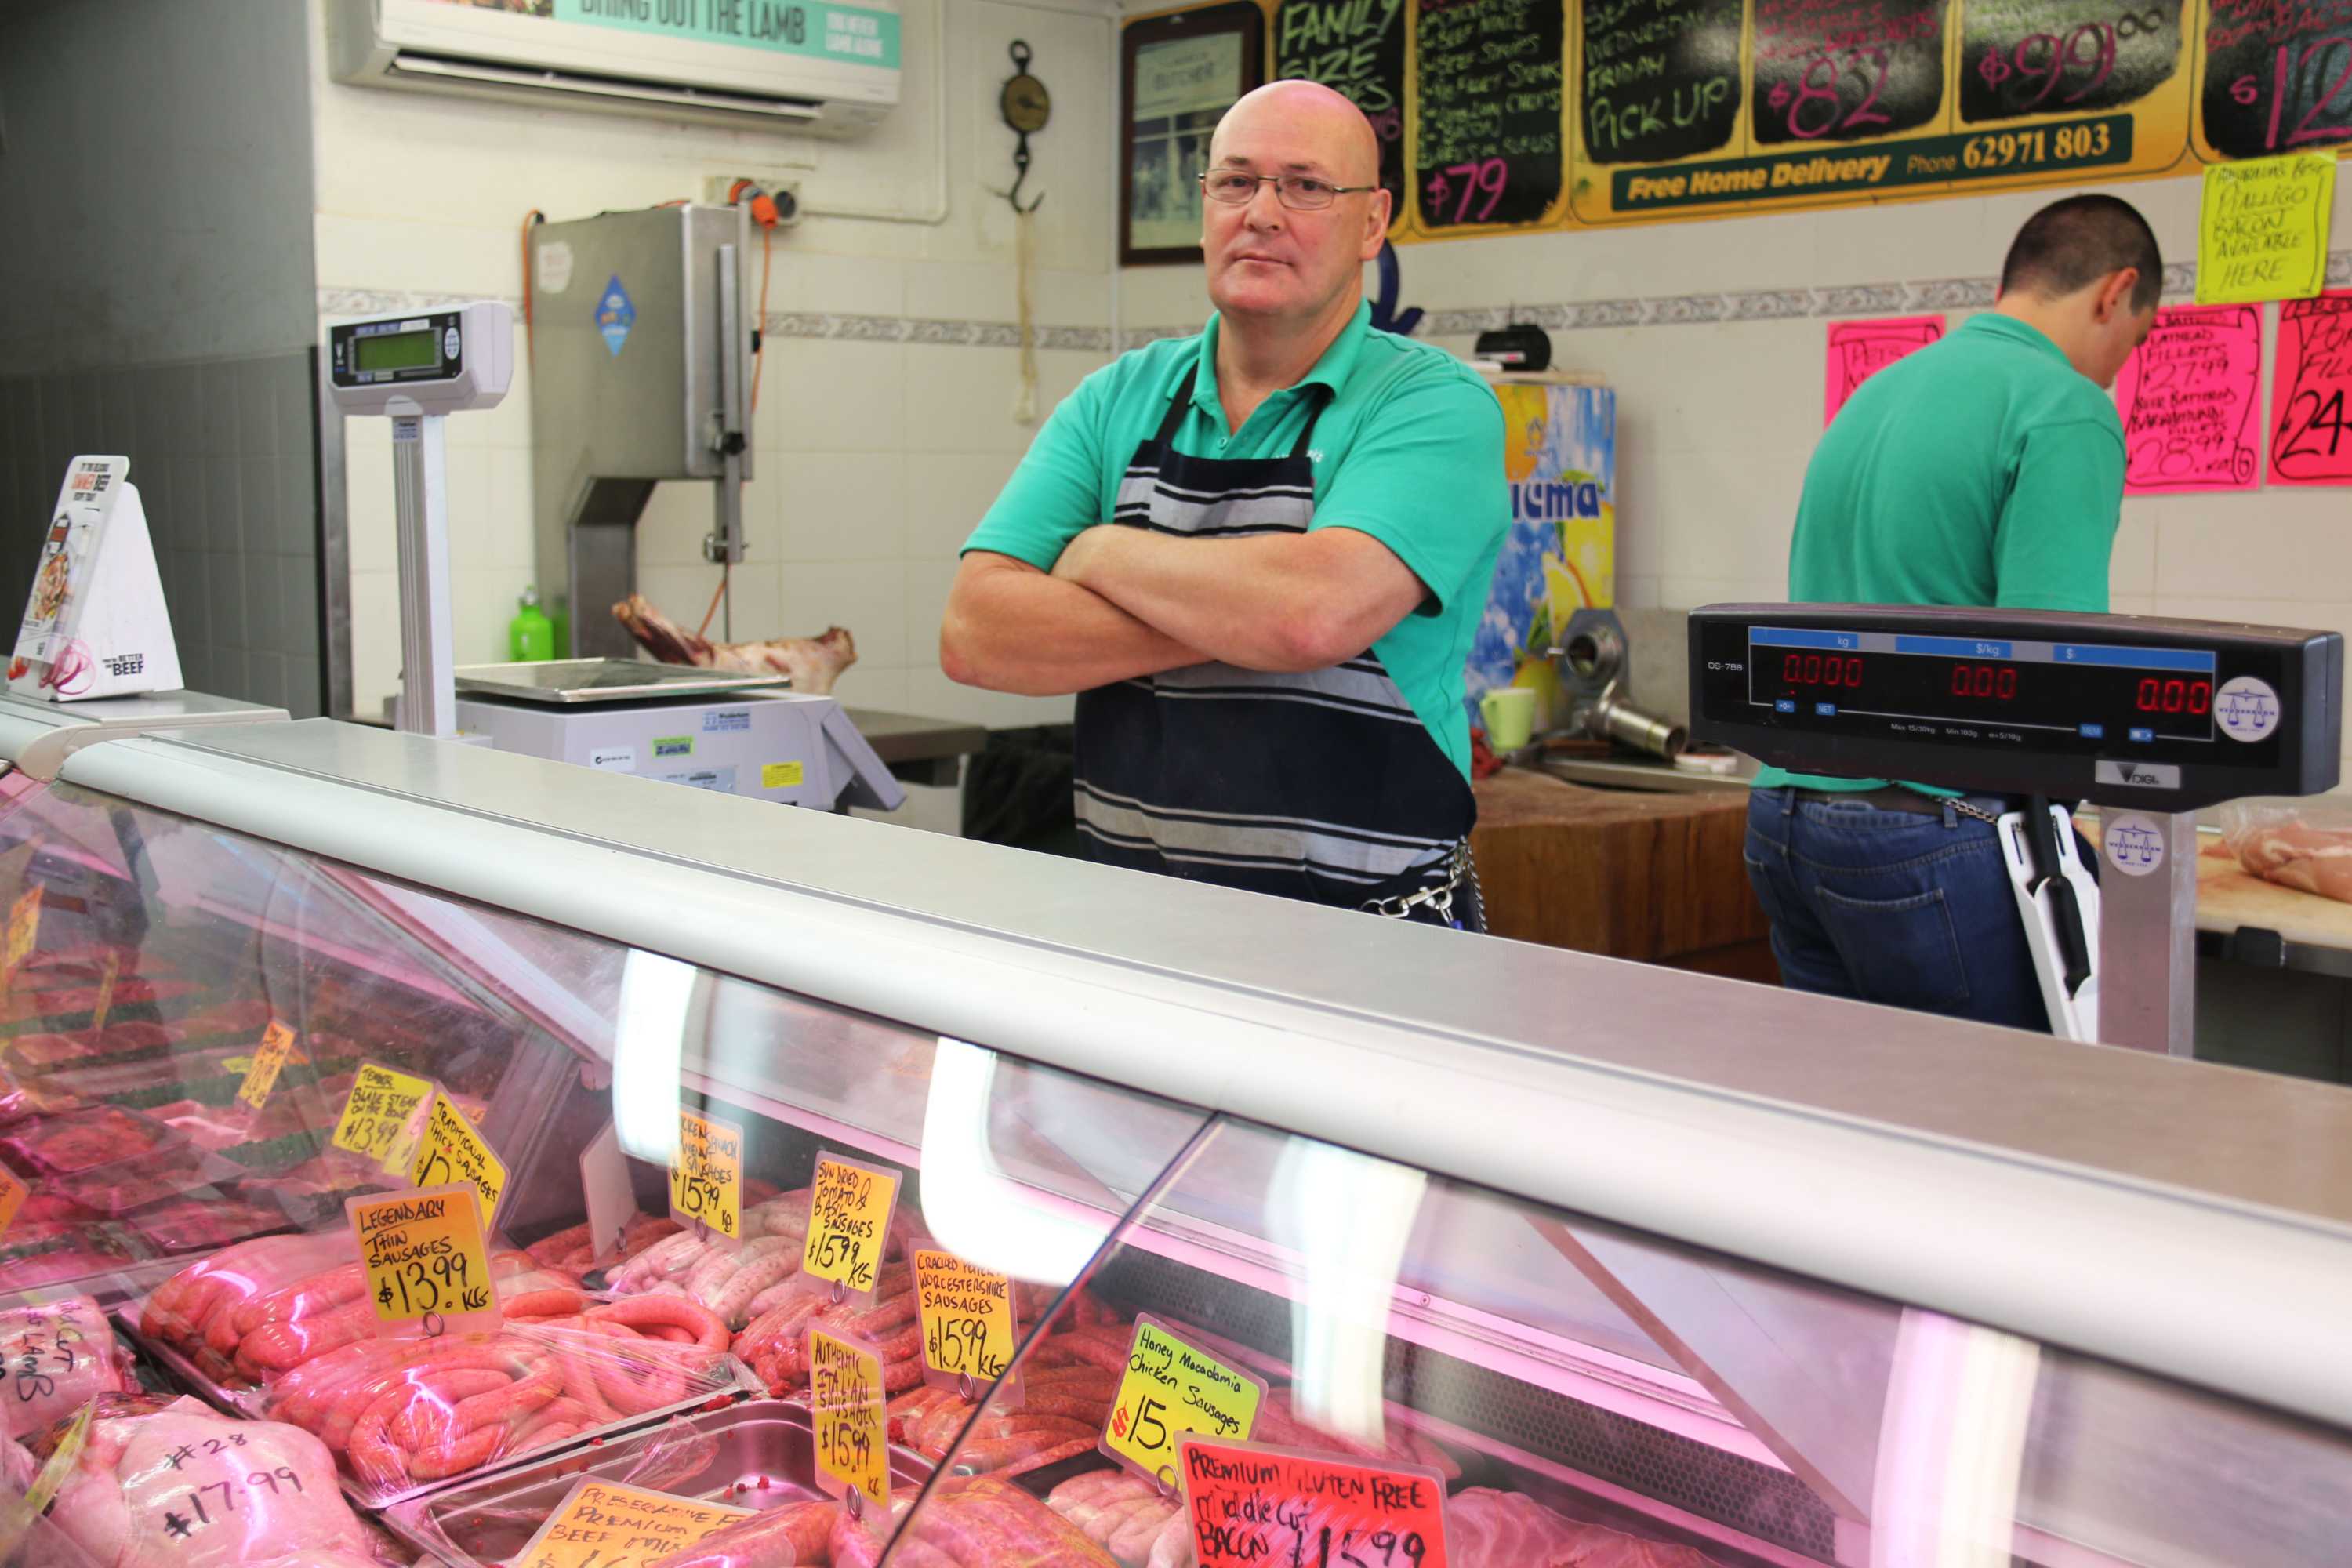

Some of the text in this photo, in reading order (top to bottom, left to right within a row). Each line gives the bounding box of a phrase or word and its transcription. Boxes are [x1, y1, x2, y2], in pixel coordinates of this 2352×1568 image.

[705, 0, 743, 37] THE
[749, 2, 806, 45] LAMB
[1279, 0, 1400, 57] FAMILY
[1279, 37, 1383, 83] SIZE
[1767, 48, 1891, 138] $82
[1590, 77, 1728, 149] PICK UP
[1628, 124, 2111, 201] Free Home Delivery Phone 62971 803
[1427, 158, 1508, 223] $79
[2219, 257, 2288, 292] HERE
[1838, 636, 1849, 648] kg
[1976, 643, 2000, 657] $/kg
[2066, 648, 2074, 659] $
[113, 661, 143, 676] BEEF
[1708, 662, 1743, 671] DS-788
[1783, 654, 1864, 688] 0.000
[1952, 666, 2017, 699] 0.00
[2136, 678, 2212, 714] 0.00
[2082, 726, 2102, 736] MEM
[2132, 774, 2157, 785] DIGI
[430, 1117, 454, 1147] THICK
[437, 1101, 486, 1170] TRADITIONAL
[456, 1150, 499, 1202] SAUSAGES
[687, 1156, 733, 1185] SAUSAGES
[818, 1161, 859, 1189] SUN DRIED
[815, 1196, 848, 1219] BASIL
[817, 1180, 855, 1207] TOMATO
[359, 1200, 445, 1233] LEGENDARY
[824, 1215, 873, 1238] SAUSAGES
[365, 1230, 408, 1254] THIN
[368, 1236, 452, 1269] SAUSAGES
[847, 1261, 873, 1287] KG
[918, 1273, 1007, 1299] WORCESTERSHIRE
[462, 1286, 489, 1311] KG
[924, 1292, 993, 1315] SAUSAGES
[815, 1334, 866, 1379] AUTHENTIC
[978, 1354, 1007, 1378] KG
[1139, 1328, 1241, 1393] Honey Macadamia
[818, 1368, 869, 1403] ITALIAN
[1129, 1354, 1241, 1436] Chicken Sausages
[820, 1392, 877, 1430] SAUSAGES
[867, 1477, 880, 1497] KG
[1189, 1448, 1282, 1487] PREMIUM
[1370, 1476, 1427, 1512] FREE
[164, 1466, 303, 1537] $17.99
[580, 1487, 711, 1524] PRESERVATIVE
[547, 1524, 617, 1543] BEEF
[573, 1506, 688, 1537] PREMIUM
